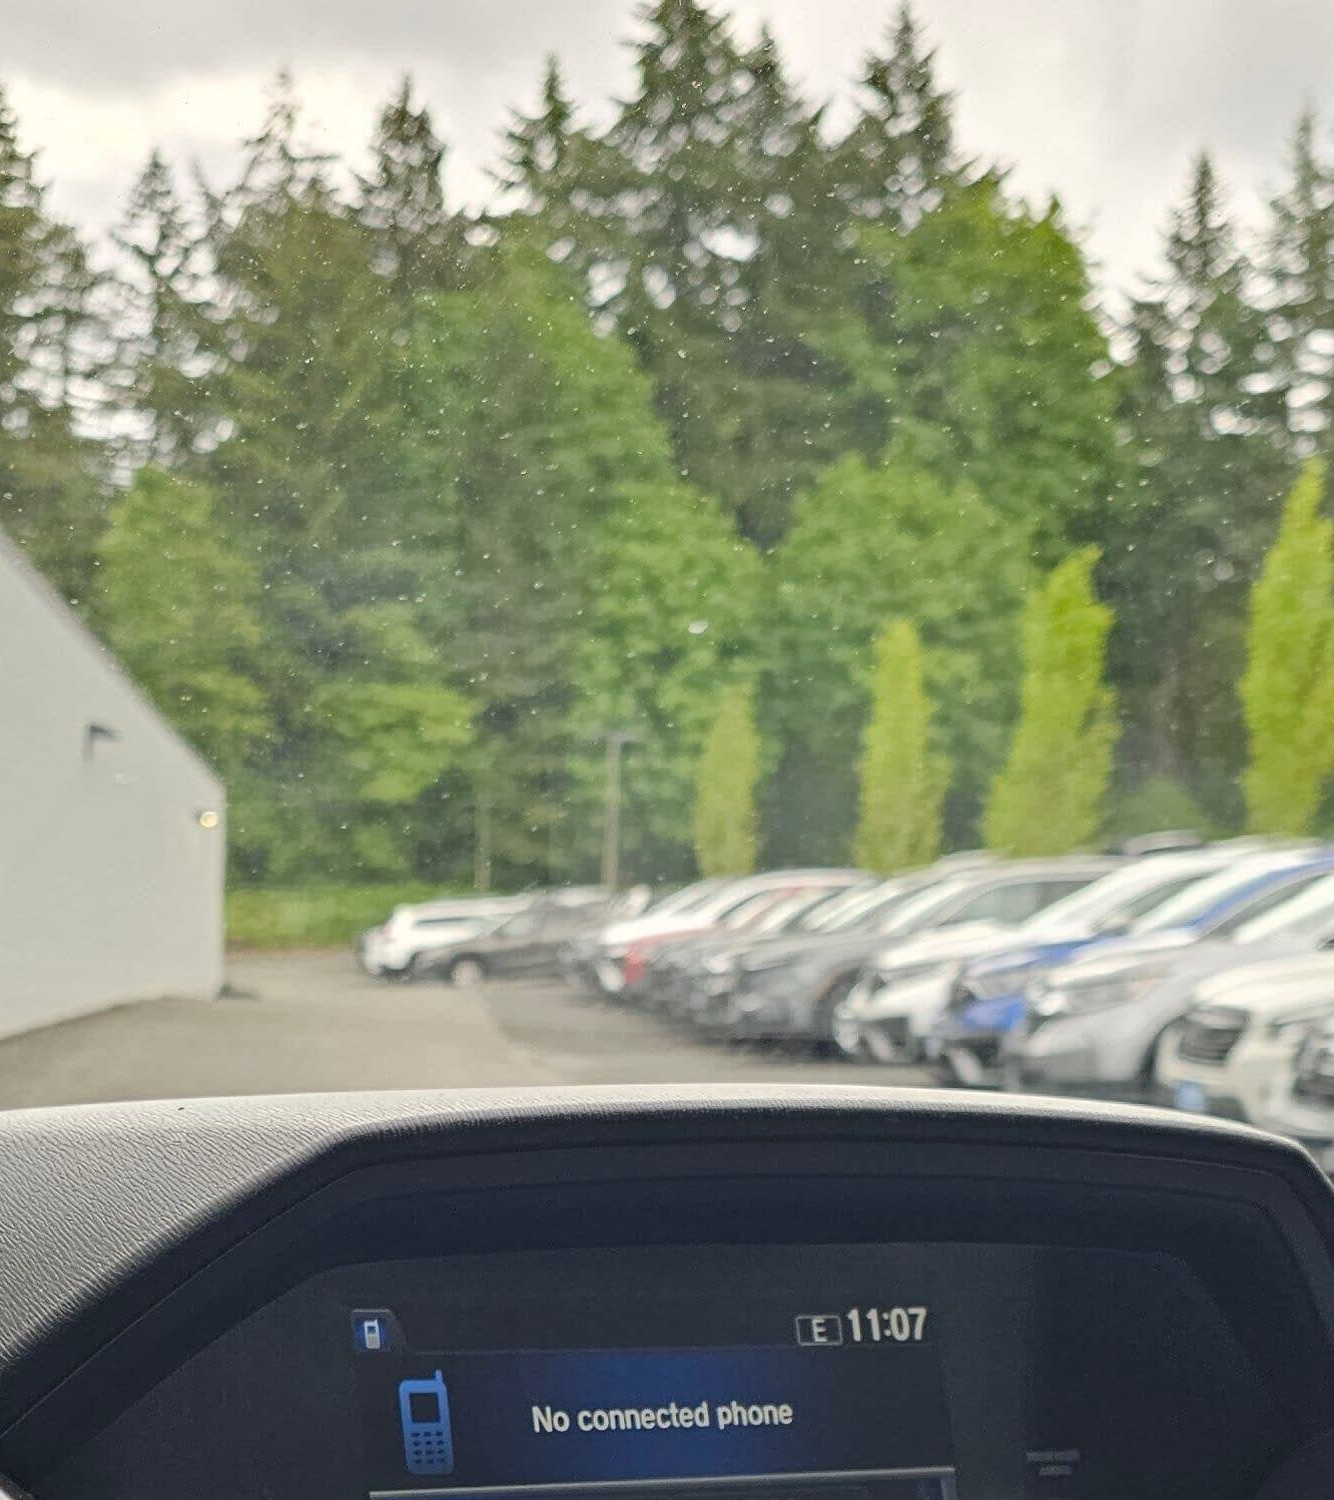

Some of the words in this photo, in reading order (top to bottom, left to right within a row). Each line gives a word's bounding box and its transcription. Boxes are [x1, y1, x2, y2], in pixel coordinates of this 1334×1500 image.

[847, 1307, 927, 1342] 11:07
[531, 1406, 570, 1433] No
[578, 1402, 710, 1432] connected
[717, 1400, 794, 1431] phone
